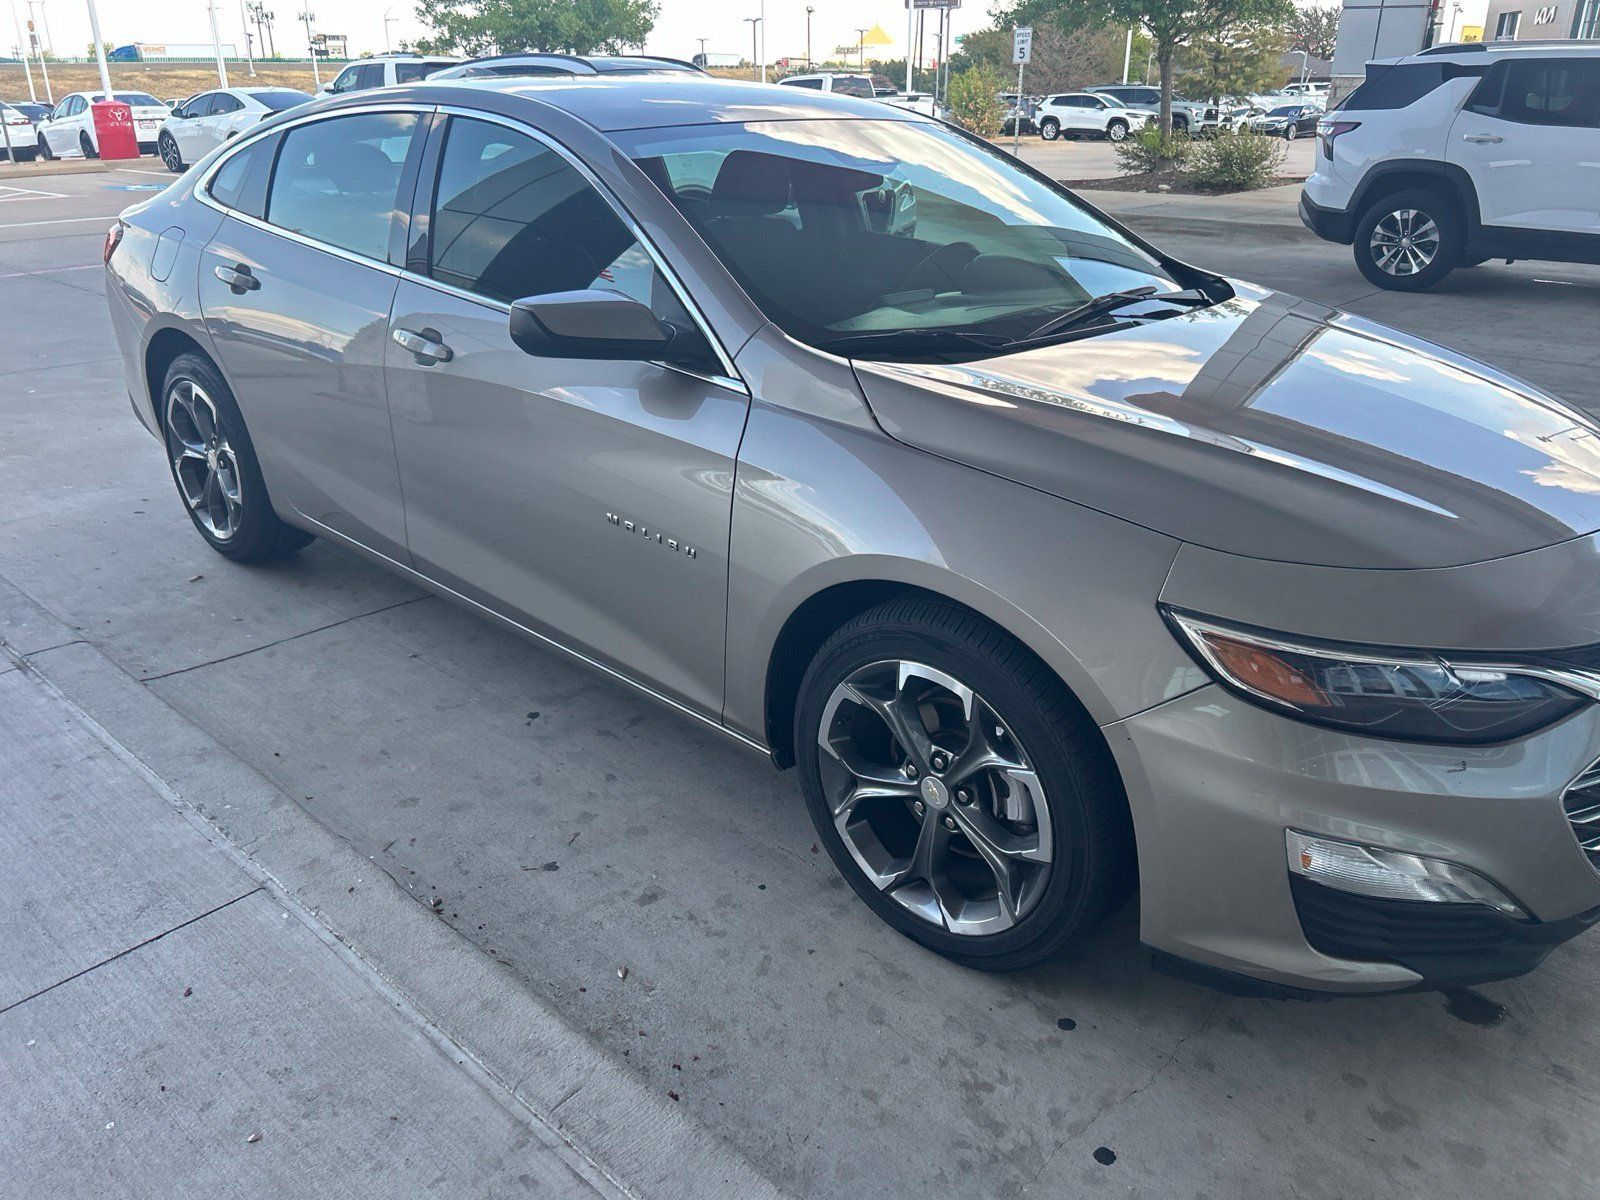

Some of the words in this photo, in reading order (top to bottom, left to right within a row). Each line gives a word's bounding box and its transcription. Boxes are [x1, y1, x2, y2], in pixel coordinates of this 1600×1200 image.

[1533, 6, 1558, 25] KIA
[1018, 47, 1026, 59] 5
[606, 512, 697, 560] MALIBU
